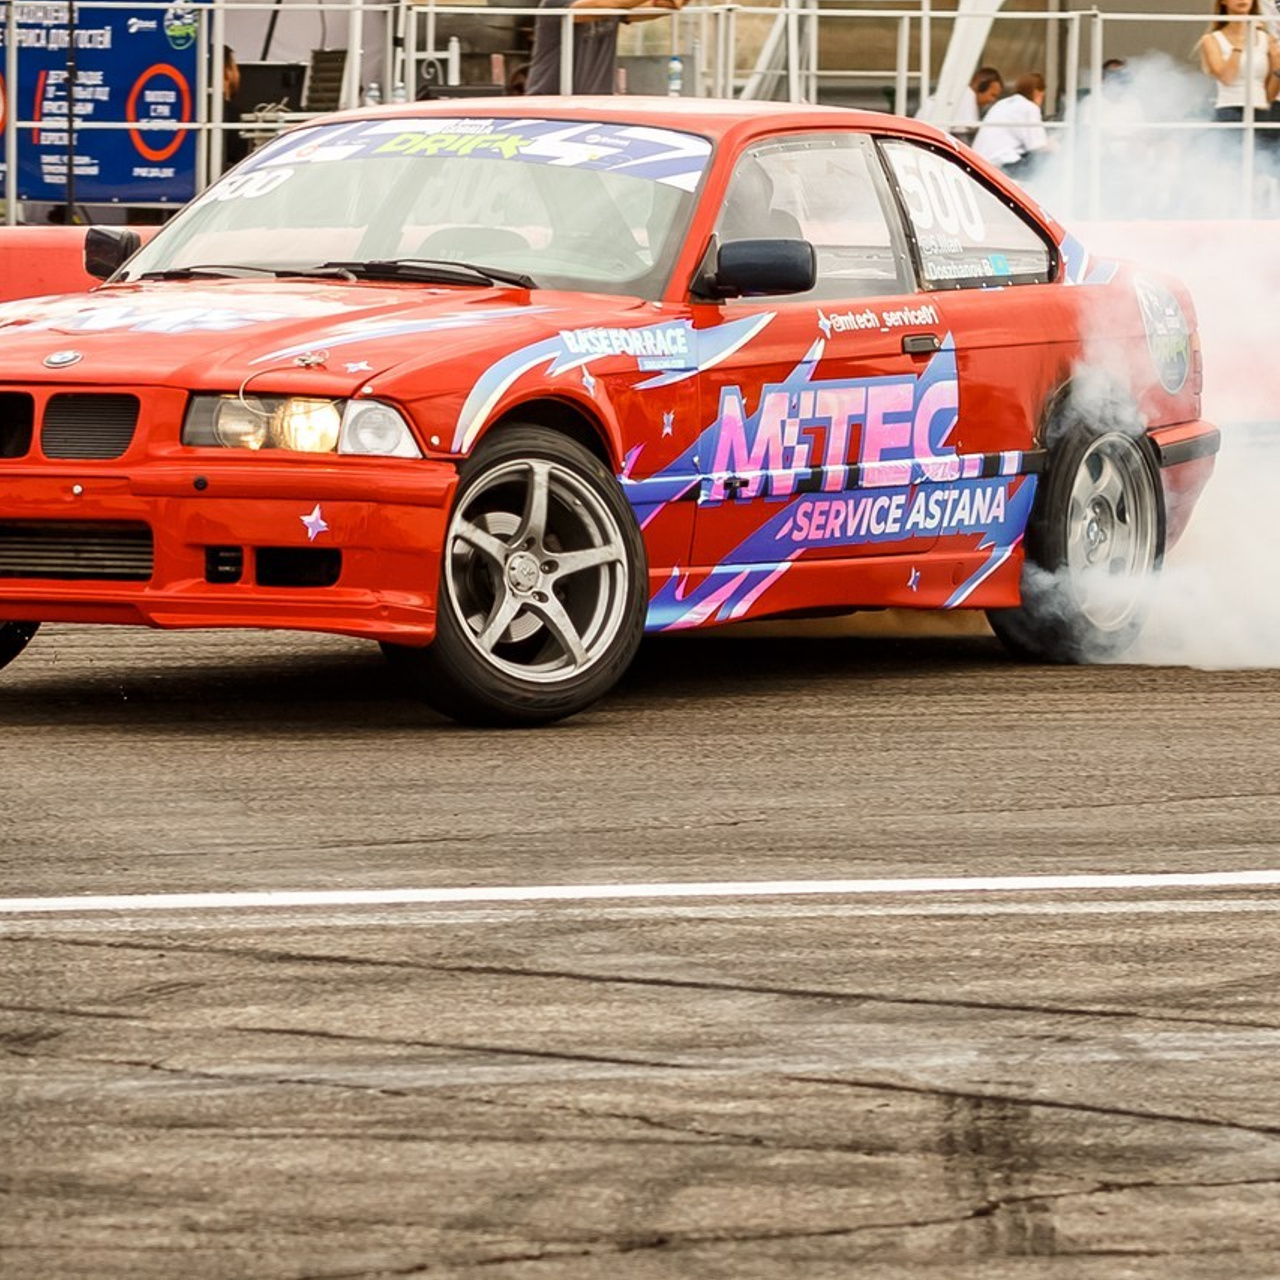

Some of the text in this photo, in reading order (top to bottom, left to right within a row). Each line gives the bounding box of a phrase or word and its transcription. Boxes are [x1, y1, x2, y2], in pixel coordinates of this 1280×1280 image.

[371, 132, 536, 159] DRIFT
[888, 148, 985, 242] 500
[829, 304, 939, 332] @mtech_service01
[792, 485, 1006, 542] SERVICE ASTANA
